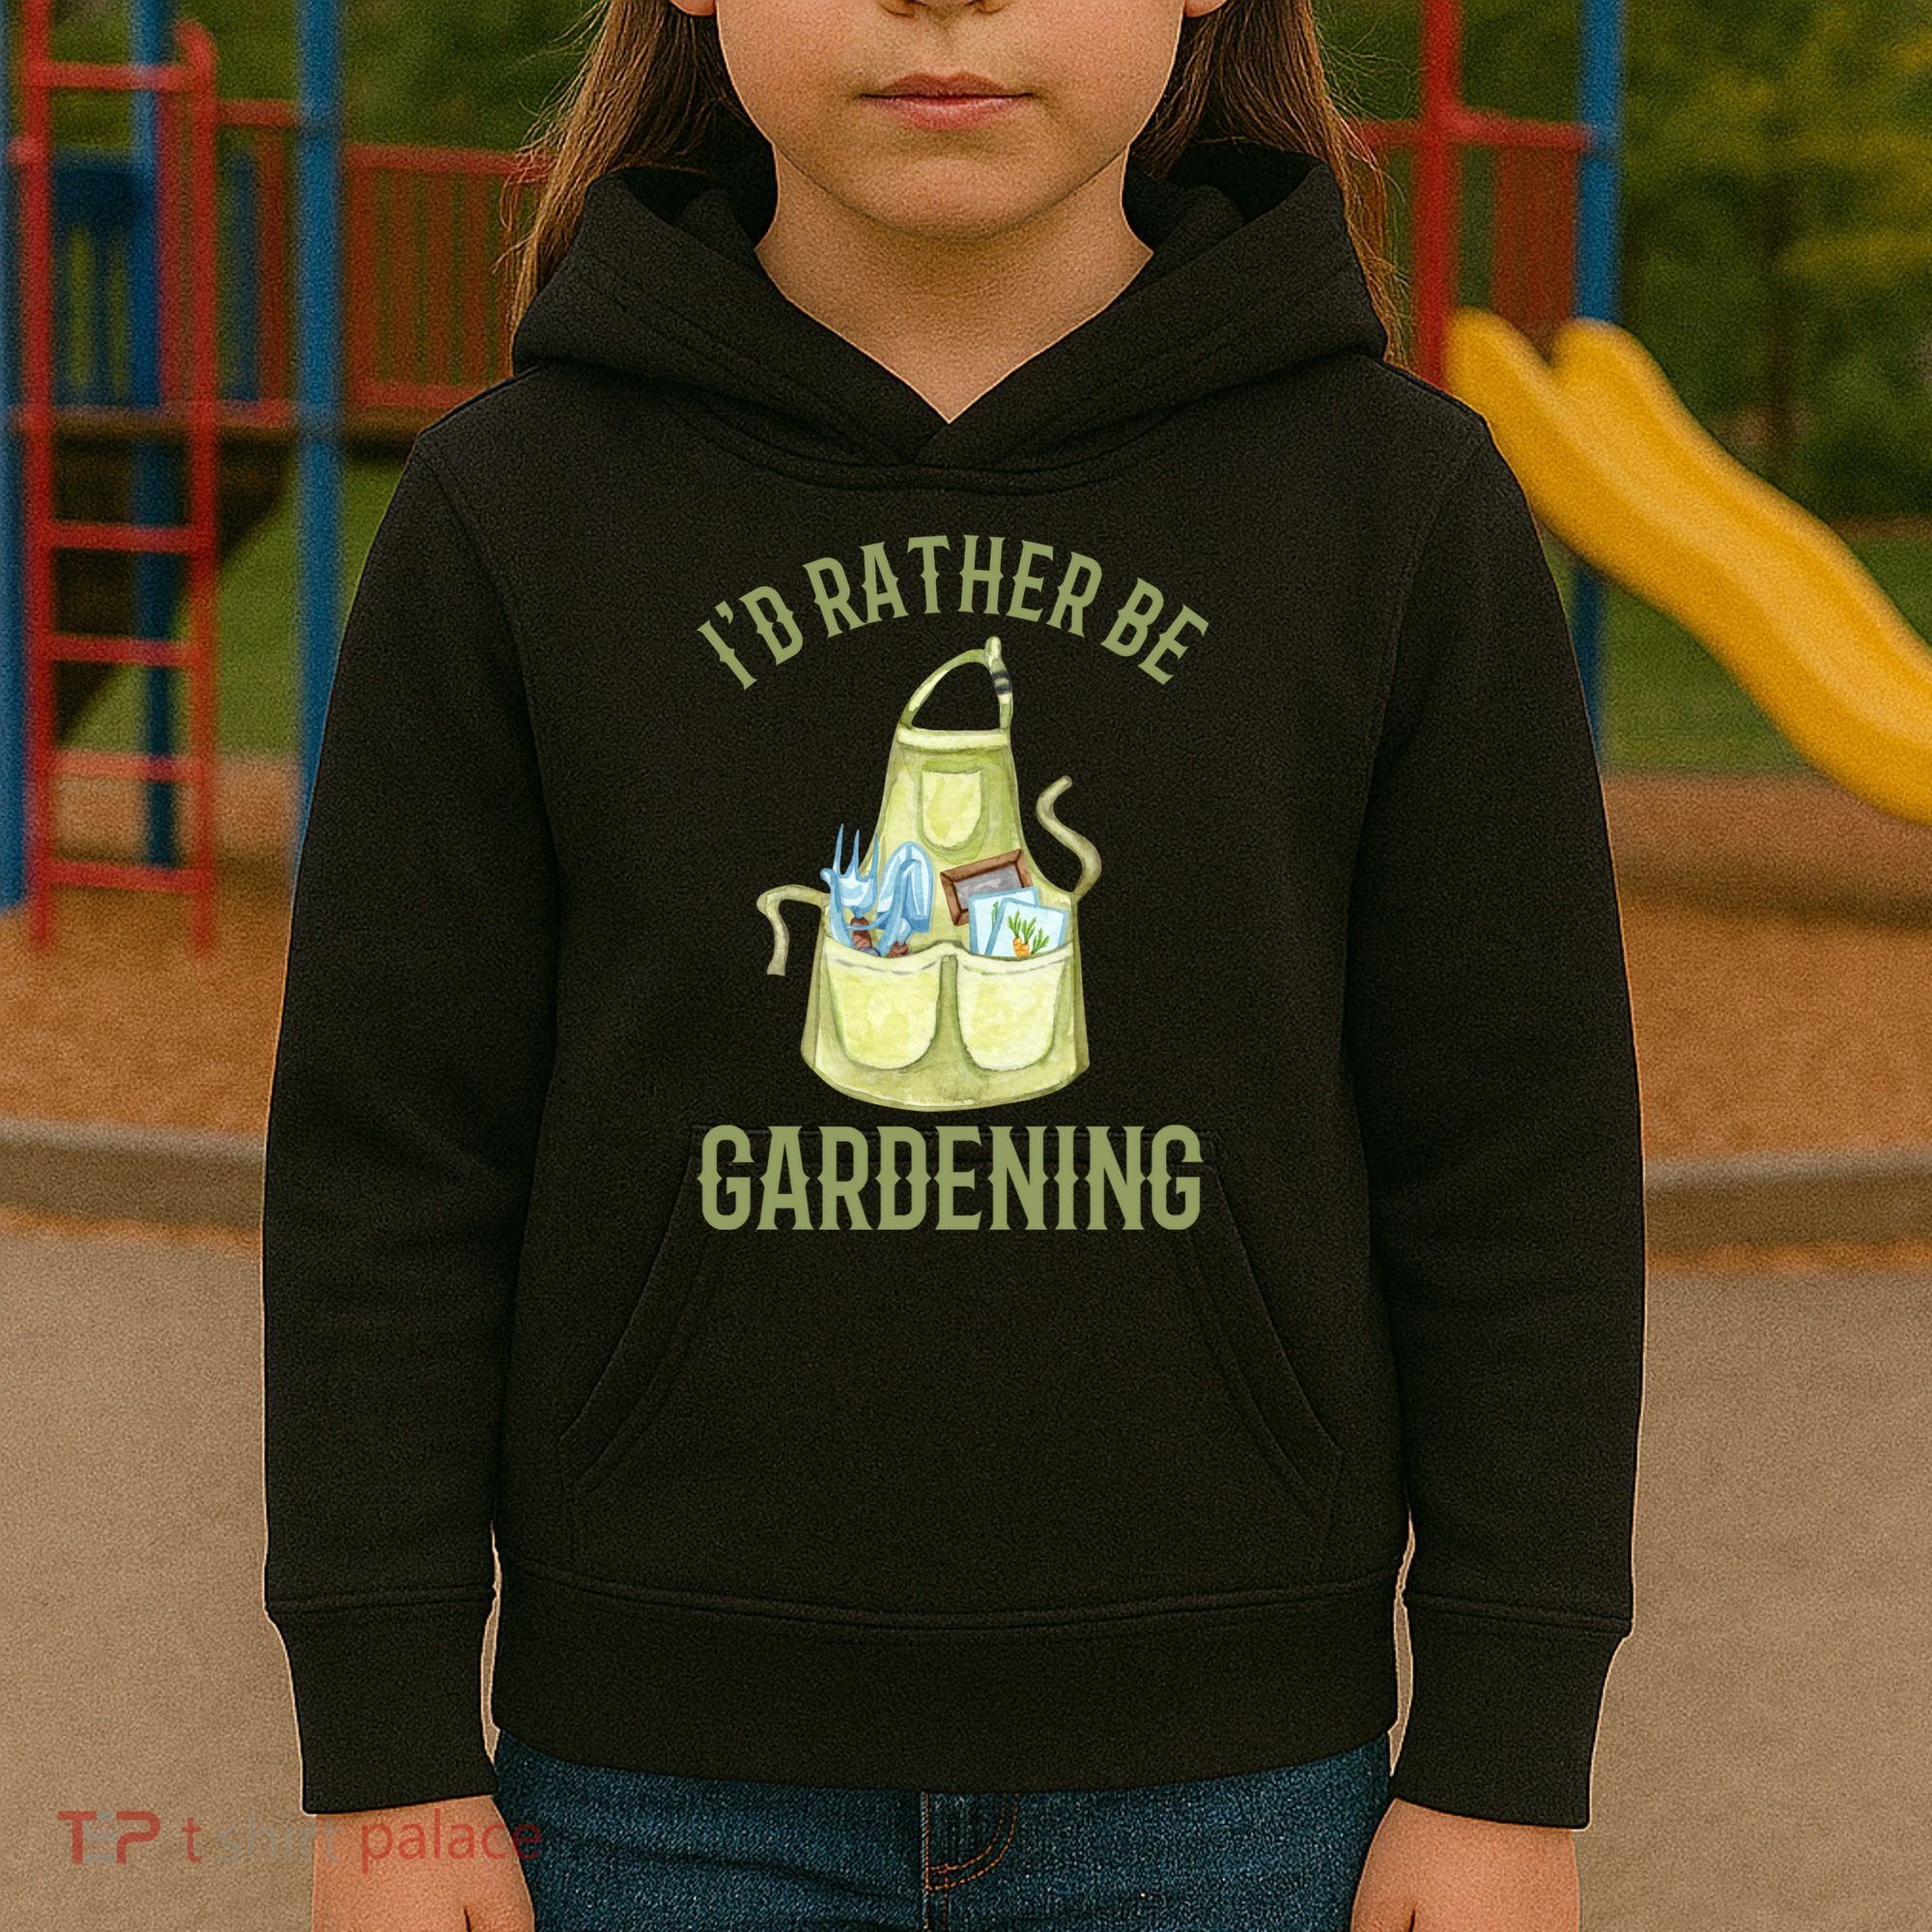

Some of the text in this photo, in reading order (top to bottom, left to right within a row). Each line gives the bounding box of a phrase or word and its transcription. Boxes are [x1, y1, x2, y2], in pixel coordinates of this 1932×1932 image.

[696, 534, 1209, 691] I'D RATHER BE
[696, 1124, 1204, 1231] GARDENING
